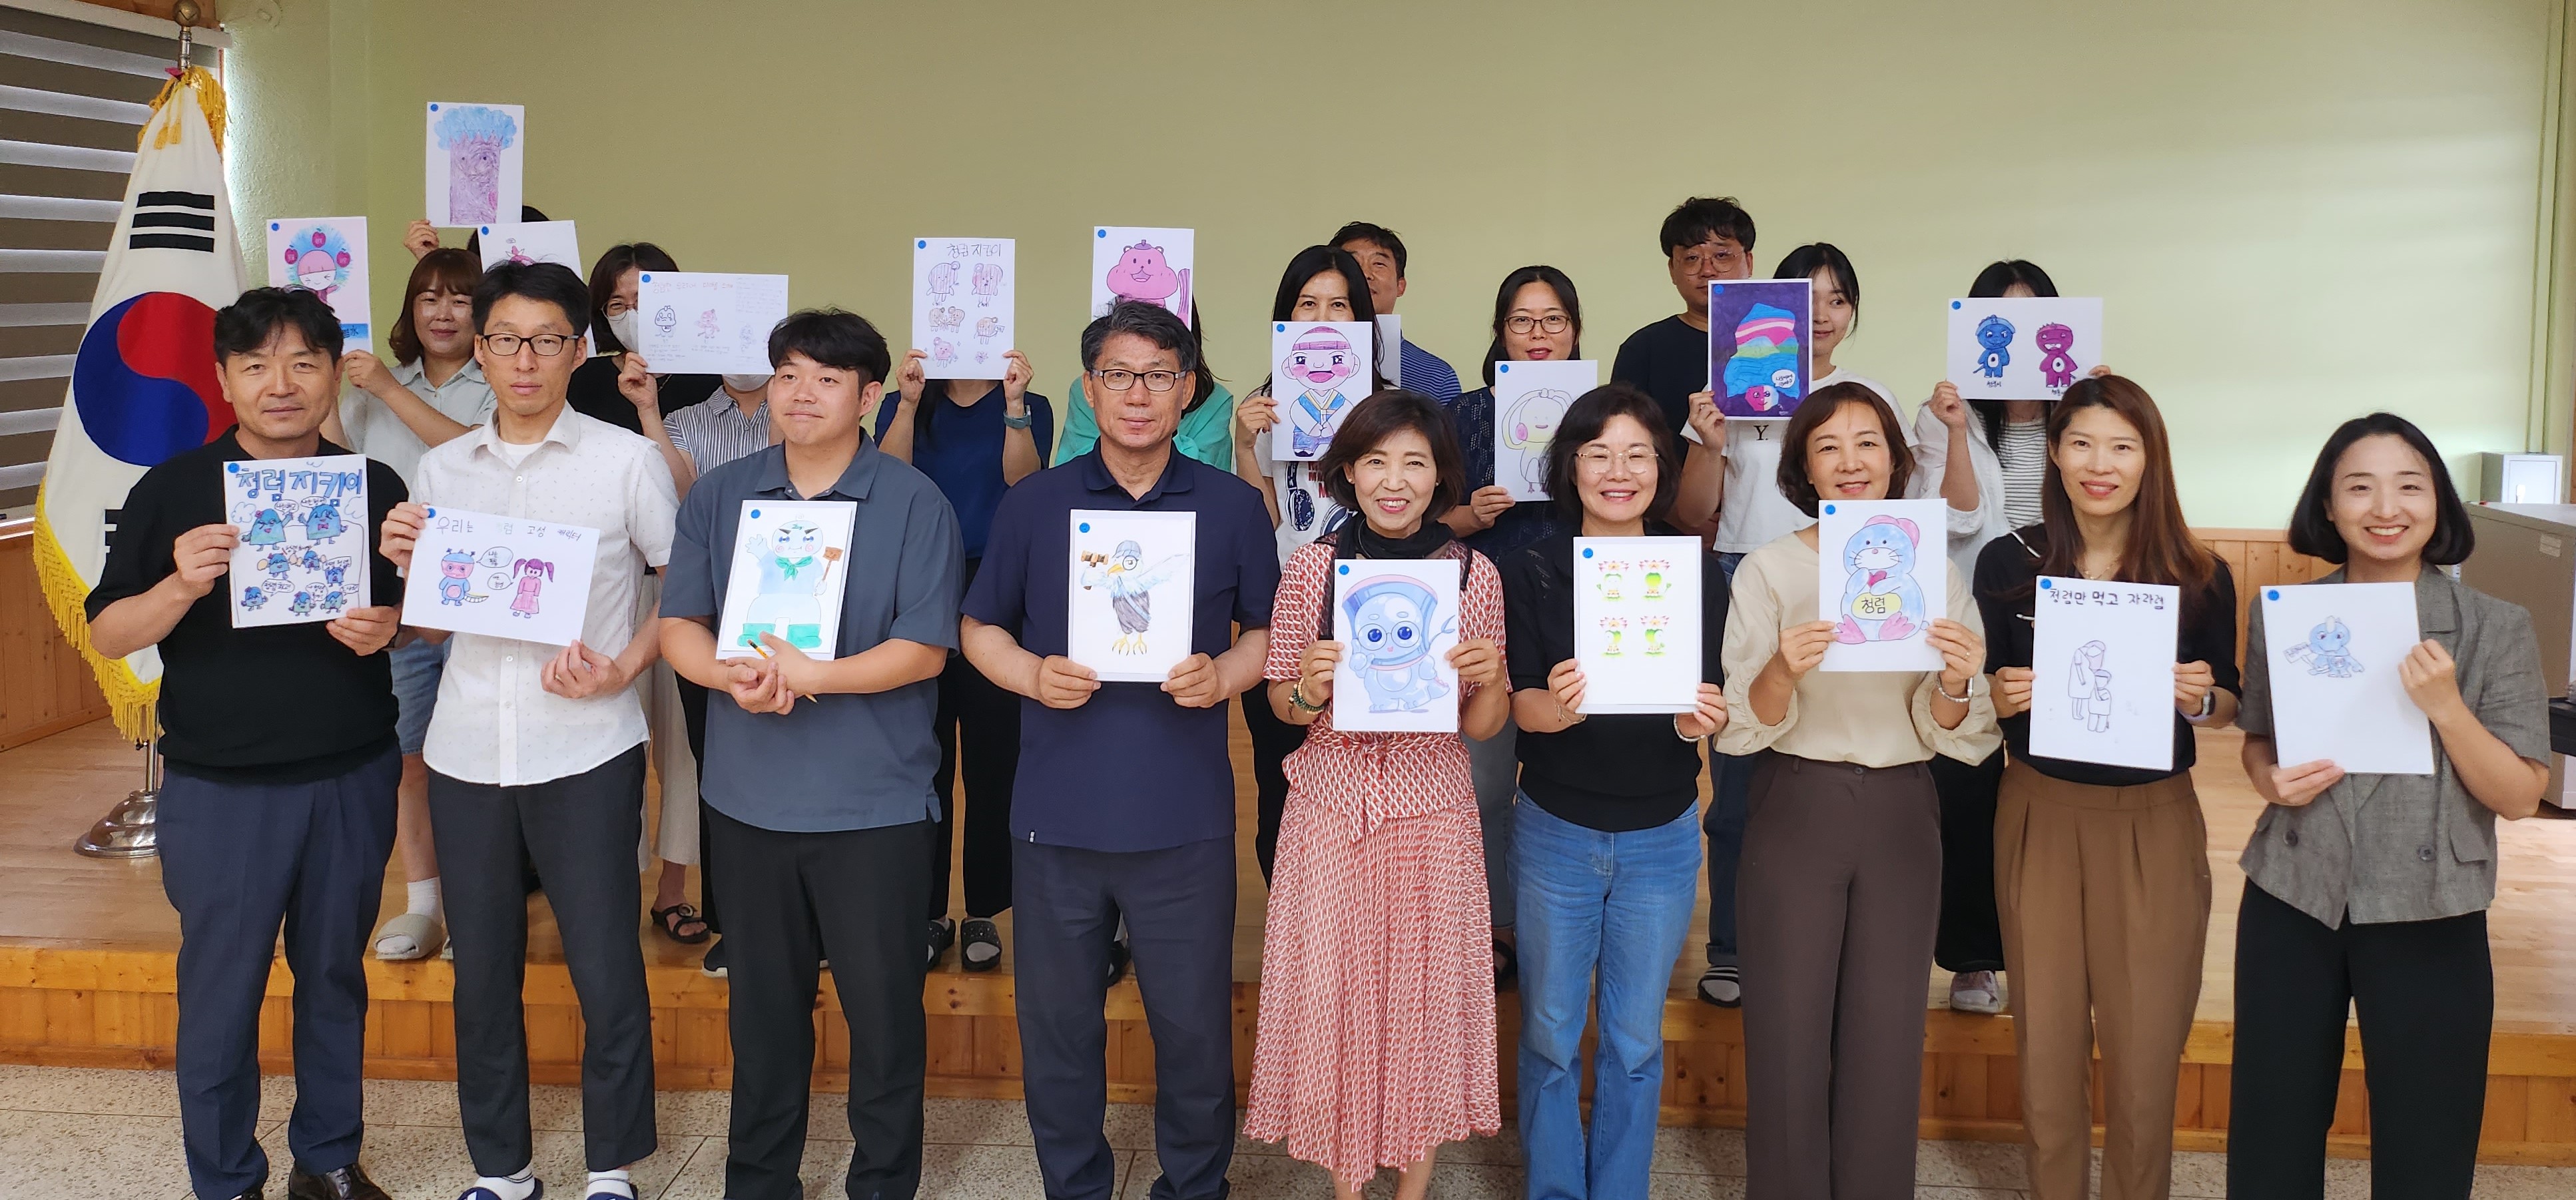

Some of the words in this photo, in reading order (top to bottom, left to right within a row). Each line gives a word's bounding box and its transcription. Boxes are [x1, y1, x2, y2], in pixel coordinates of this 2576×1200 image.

[946, 242, 968, 258] 청렴
[970, 243, 1002, 257] 지킴이
[1754, 425, 1769, 441] Y.
[236, 468, 286, 501] 청렴
[289, 469, 363, 507] 지킴이
[436, 516, 474, 535] 우리는
[527, 525, 546, 537] 고성
[557, 529, 581, 541] 캐릭터
[1861, 597, 1885, 614] 청렴
[2050, 588, 2087, 605] 청렴만
[2092, 591, 2118, 606] 먹고
[2127, 593, 2164, 610] 자라렴
